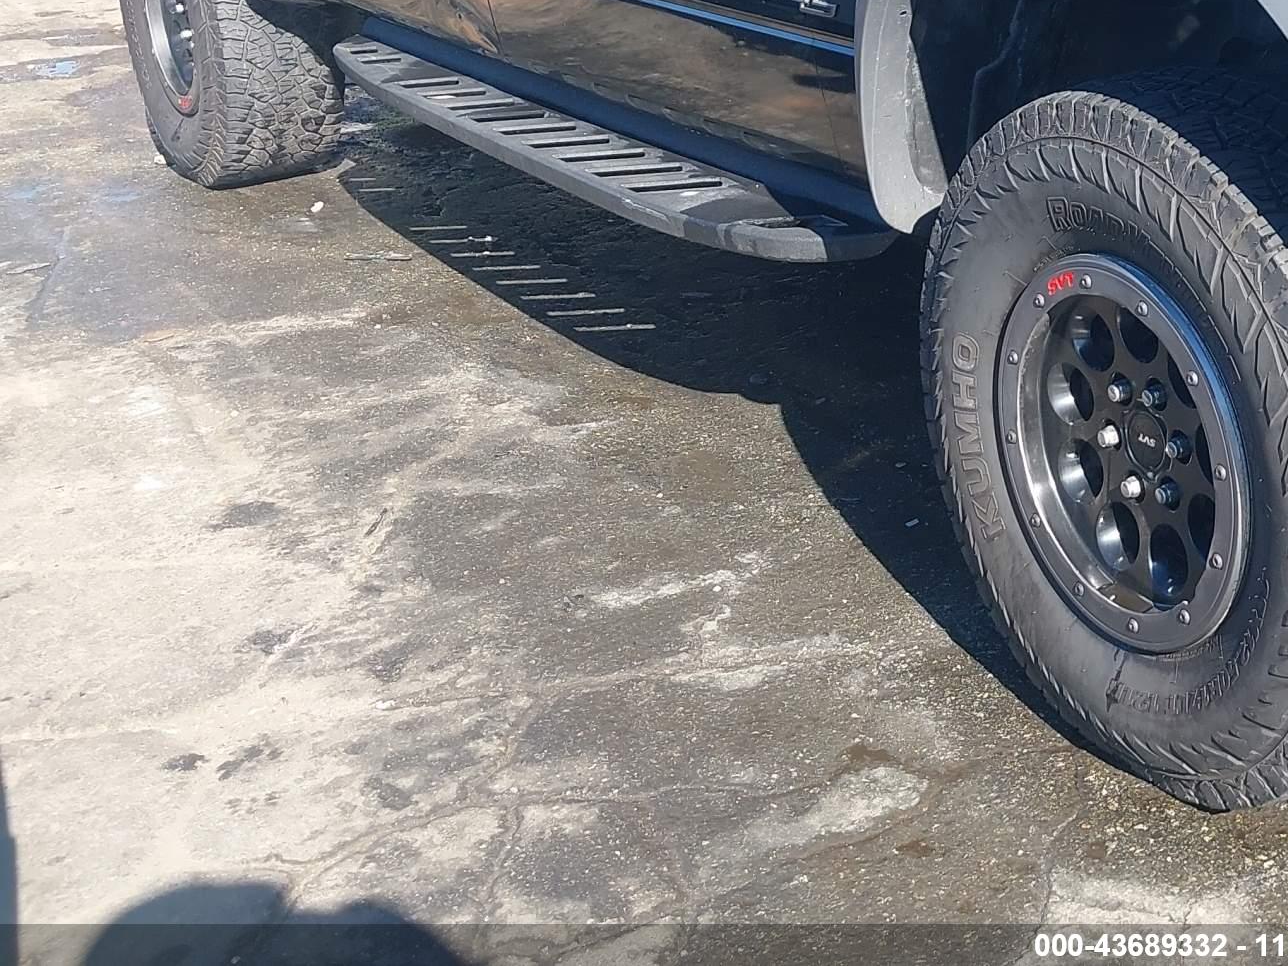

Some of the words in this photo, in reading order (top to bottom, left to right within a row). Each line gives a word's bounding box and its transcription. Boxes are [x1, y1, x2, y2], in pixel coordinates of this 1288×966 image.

[1047, 271, 1074, 296] SVT
[951, 333, 1006, 540] KUMHO
[1138, 433, 1157, 448] SVT
